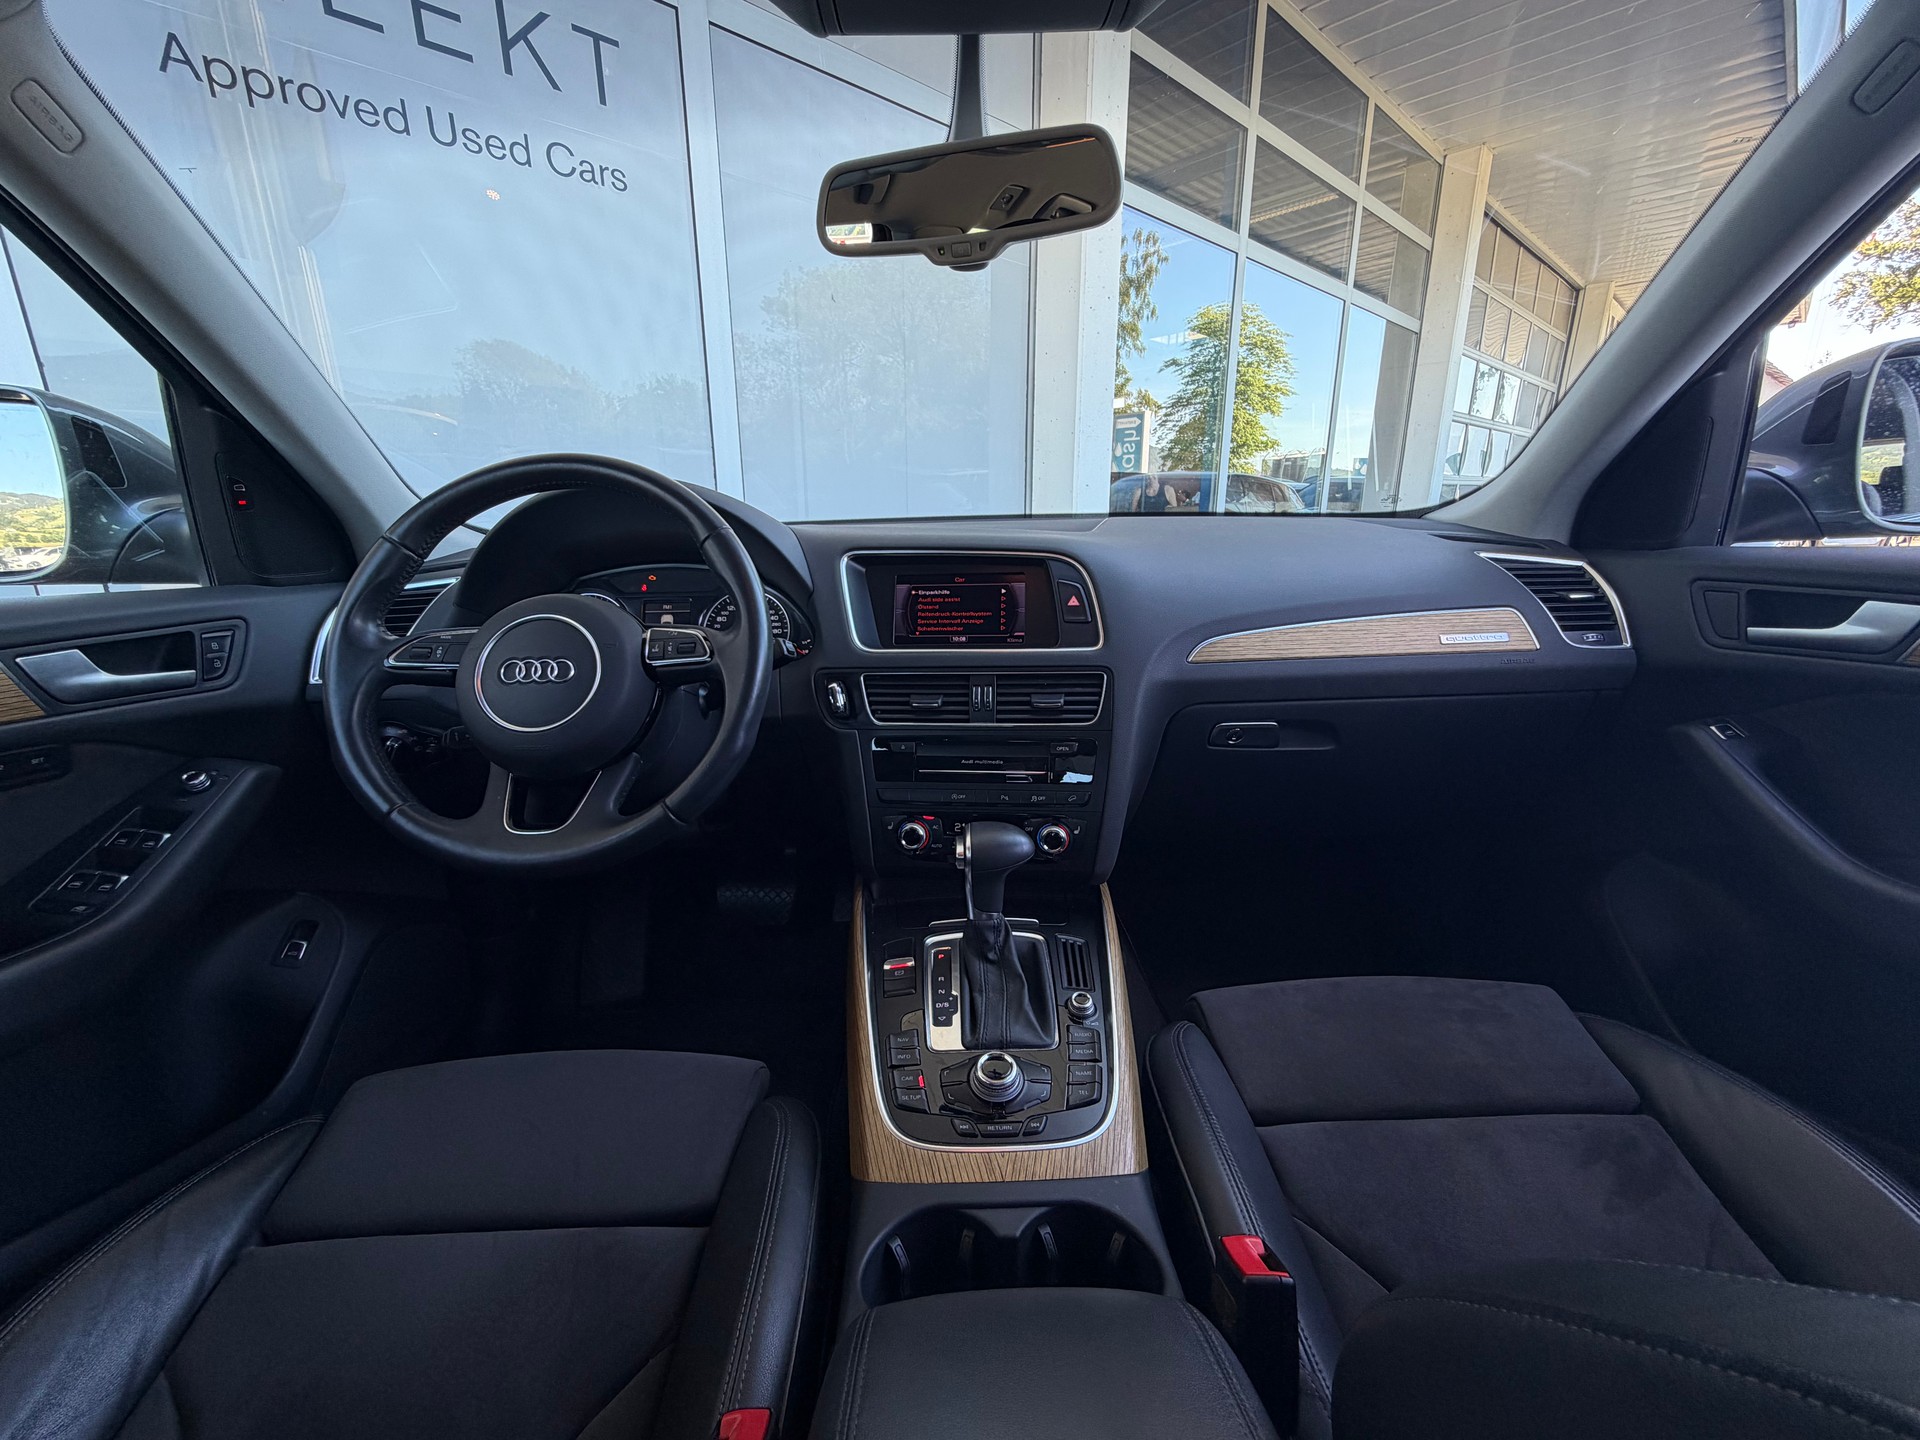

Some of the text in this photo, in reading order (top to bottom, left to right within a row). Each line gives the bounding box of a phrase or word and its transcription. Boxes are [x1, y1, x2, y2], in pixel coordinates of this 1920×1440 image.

[158, 31, 629, 193] Approved Used Cars
